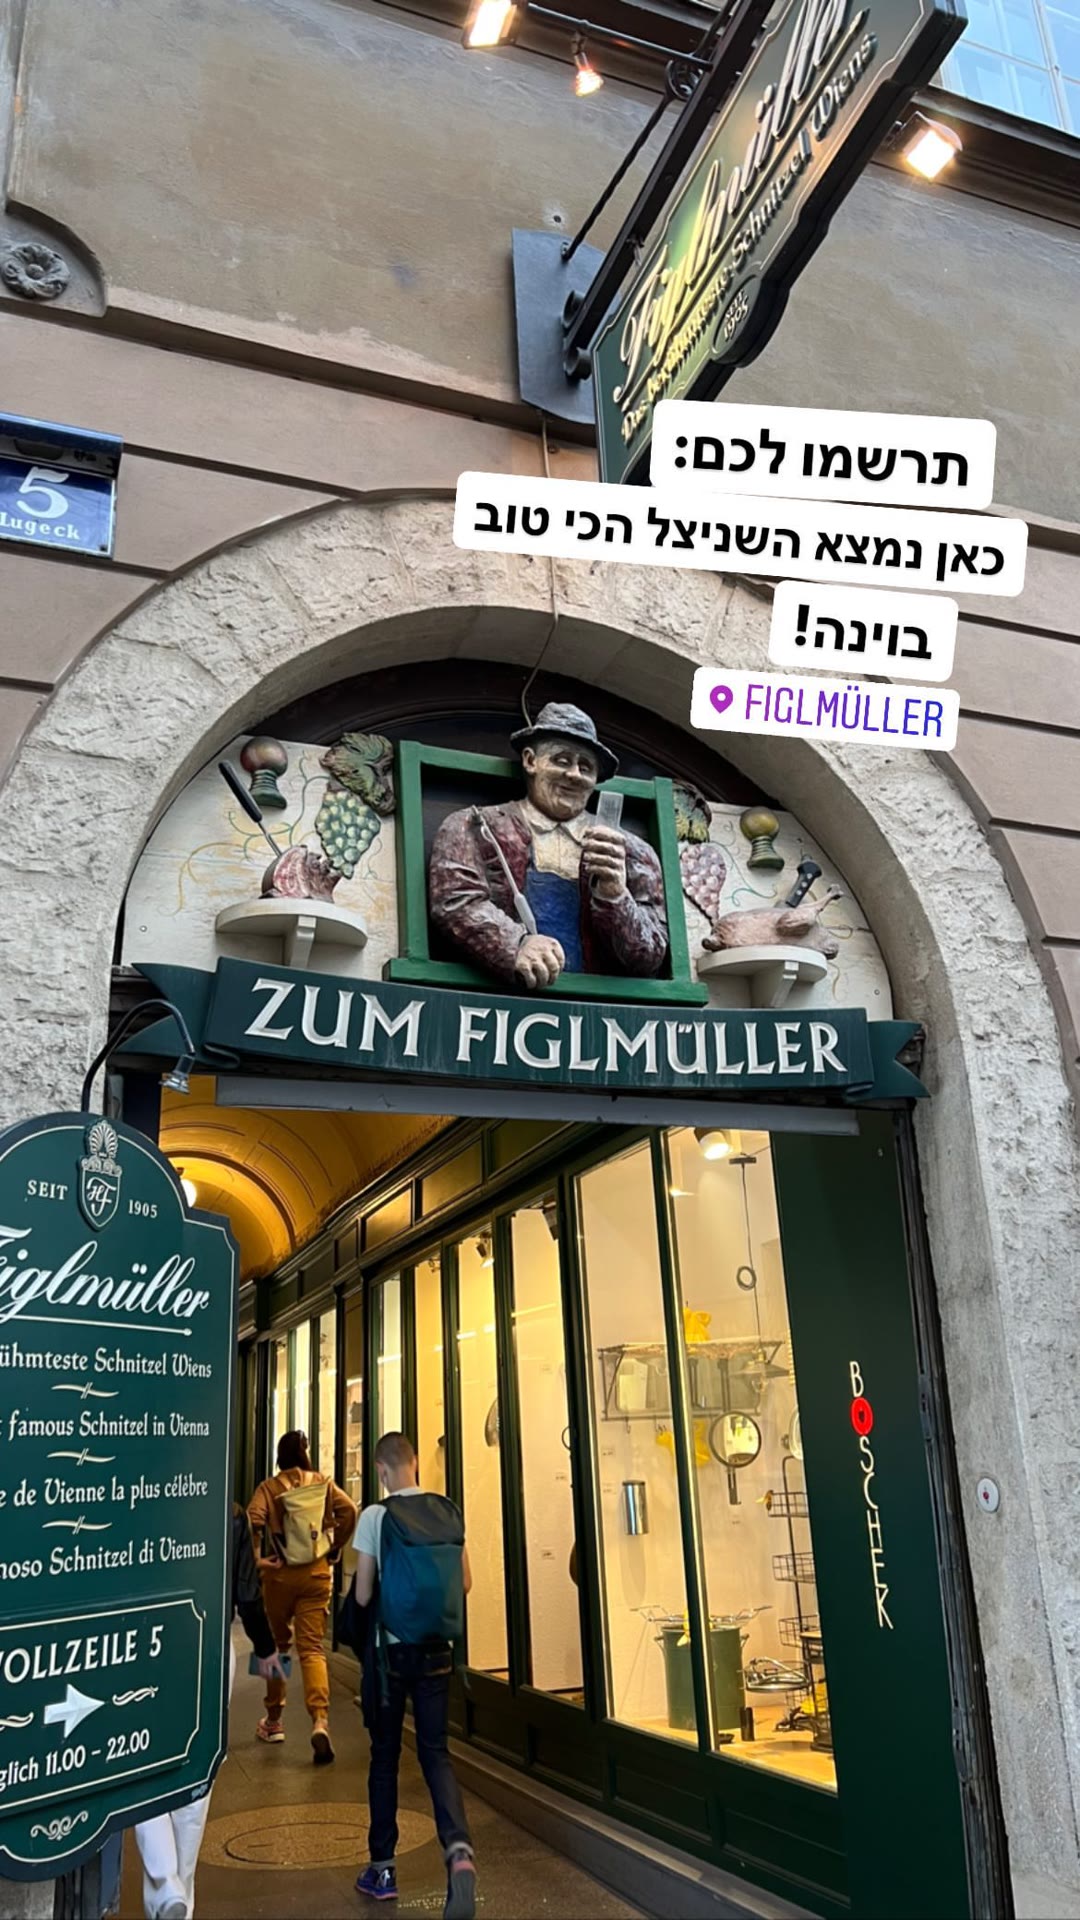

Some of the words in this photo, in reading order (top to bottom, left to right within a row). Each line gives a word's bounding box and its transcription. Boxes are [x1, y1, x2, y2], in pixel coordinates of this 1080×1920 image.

[731, 128, 811, 265] Schnitzel
[810, 32, 878, 141] Wiens
[723, 296, 749, 342] 1905
[16, 466, 69, 519] 5
[0, 511, 80, 540] Lugeck
[244, 977, 426, 1057] ZUM
[456, 1005, 849, 1075] FIGLMÜLLER
[27, 1179, 68, 1201] SEIT
[128, 1199, 158, 1219] 1905
[0, 1342, 89, 1371] ühmteste
[94, 1347, 167, 1376] Schnitzel
[172, 1353, 212, 1378] Wiens
[8, 1409, 75, 1441] famous
[79, 1410, 148, 1437] Schnitzel
[153, 1415, 165, 1436] in
[170, 1412, 210, 1437] Vienna
[13, 1478, 37, 1507] de
[44, 1477, 105, 1505] Vienne
[111, 1475, 125, 1501] la
[130, 1474, 161, 1510] plus
[164, 1472, 209, 1498] célèbre
[849, 1361, 895, 1630] BOSCHEK
[49, 1540, 134, 1575] Schnitzel
[139, 1538, 154, 1565] di
[159, 1536, 206, 1562] Vienna
[0, 1629, 138, 1684] OLLZEILE
[149, 1625, 165, 1657] 5
[45, 1745, 86, 1776] 11.00
[105, 1728, 150, 1763] 22.00
